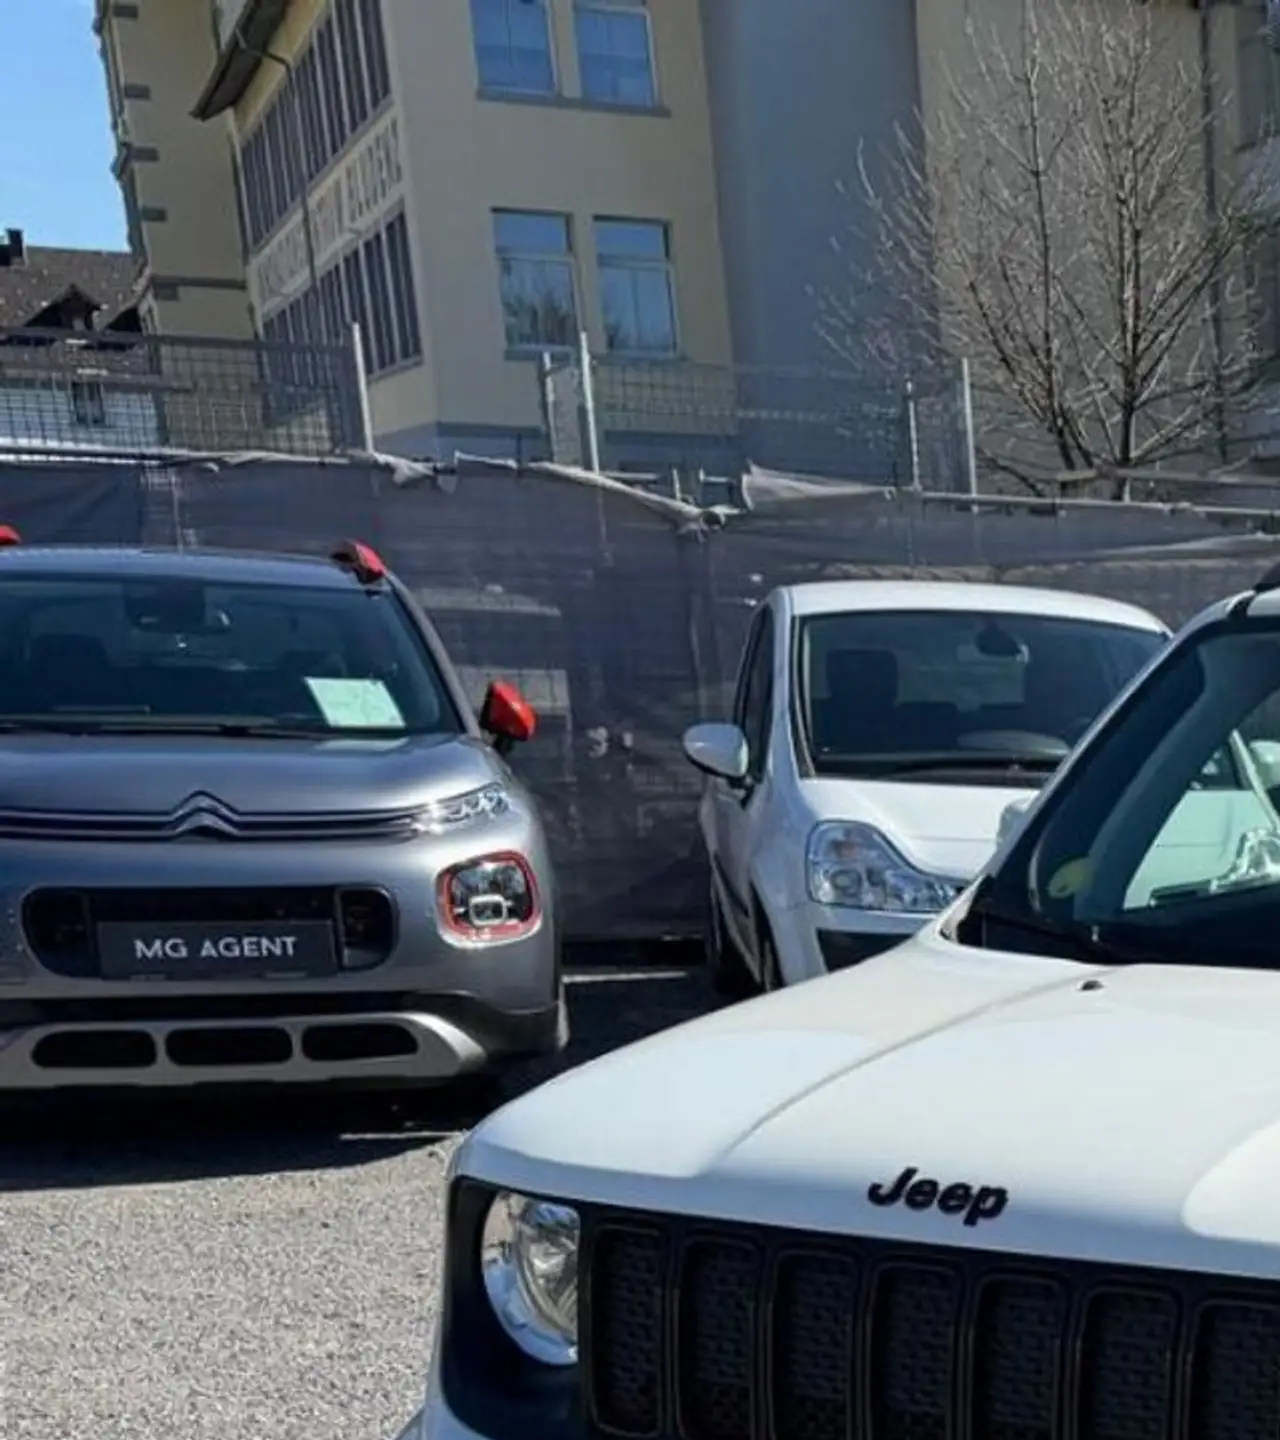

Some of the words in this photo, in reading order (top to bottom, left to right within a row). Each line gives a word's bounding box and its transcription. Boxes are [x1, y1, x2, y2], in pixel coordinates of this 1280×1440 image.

[133, 938, 188, 959] MG
[200, 936, 297, 958] AGENT
[866, 1166, 1009, 1228] Jeep
